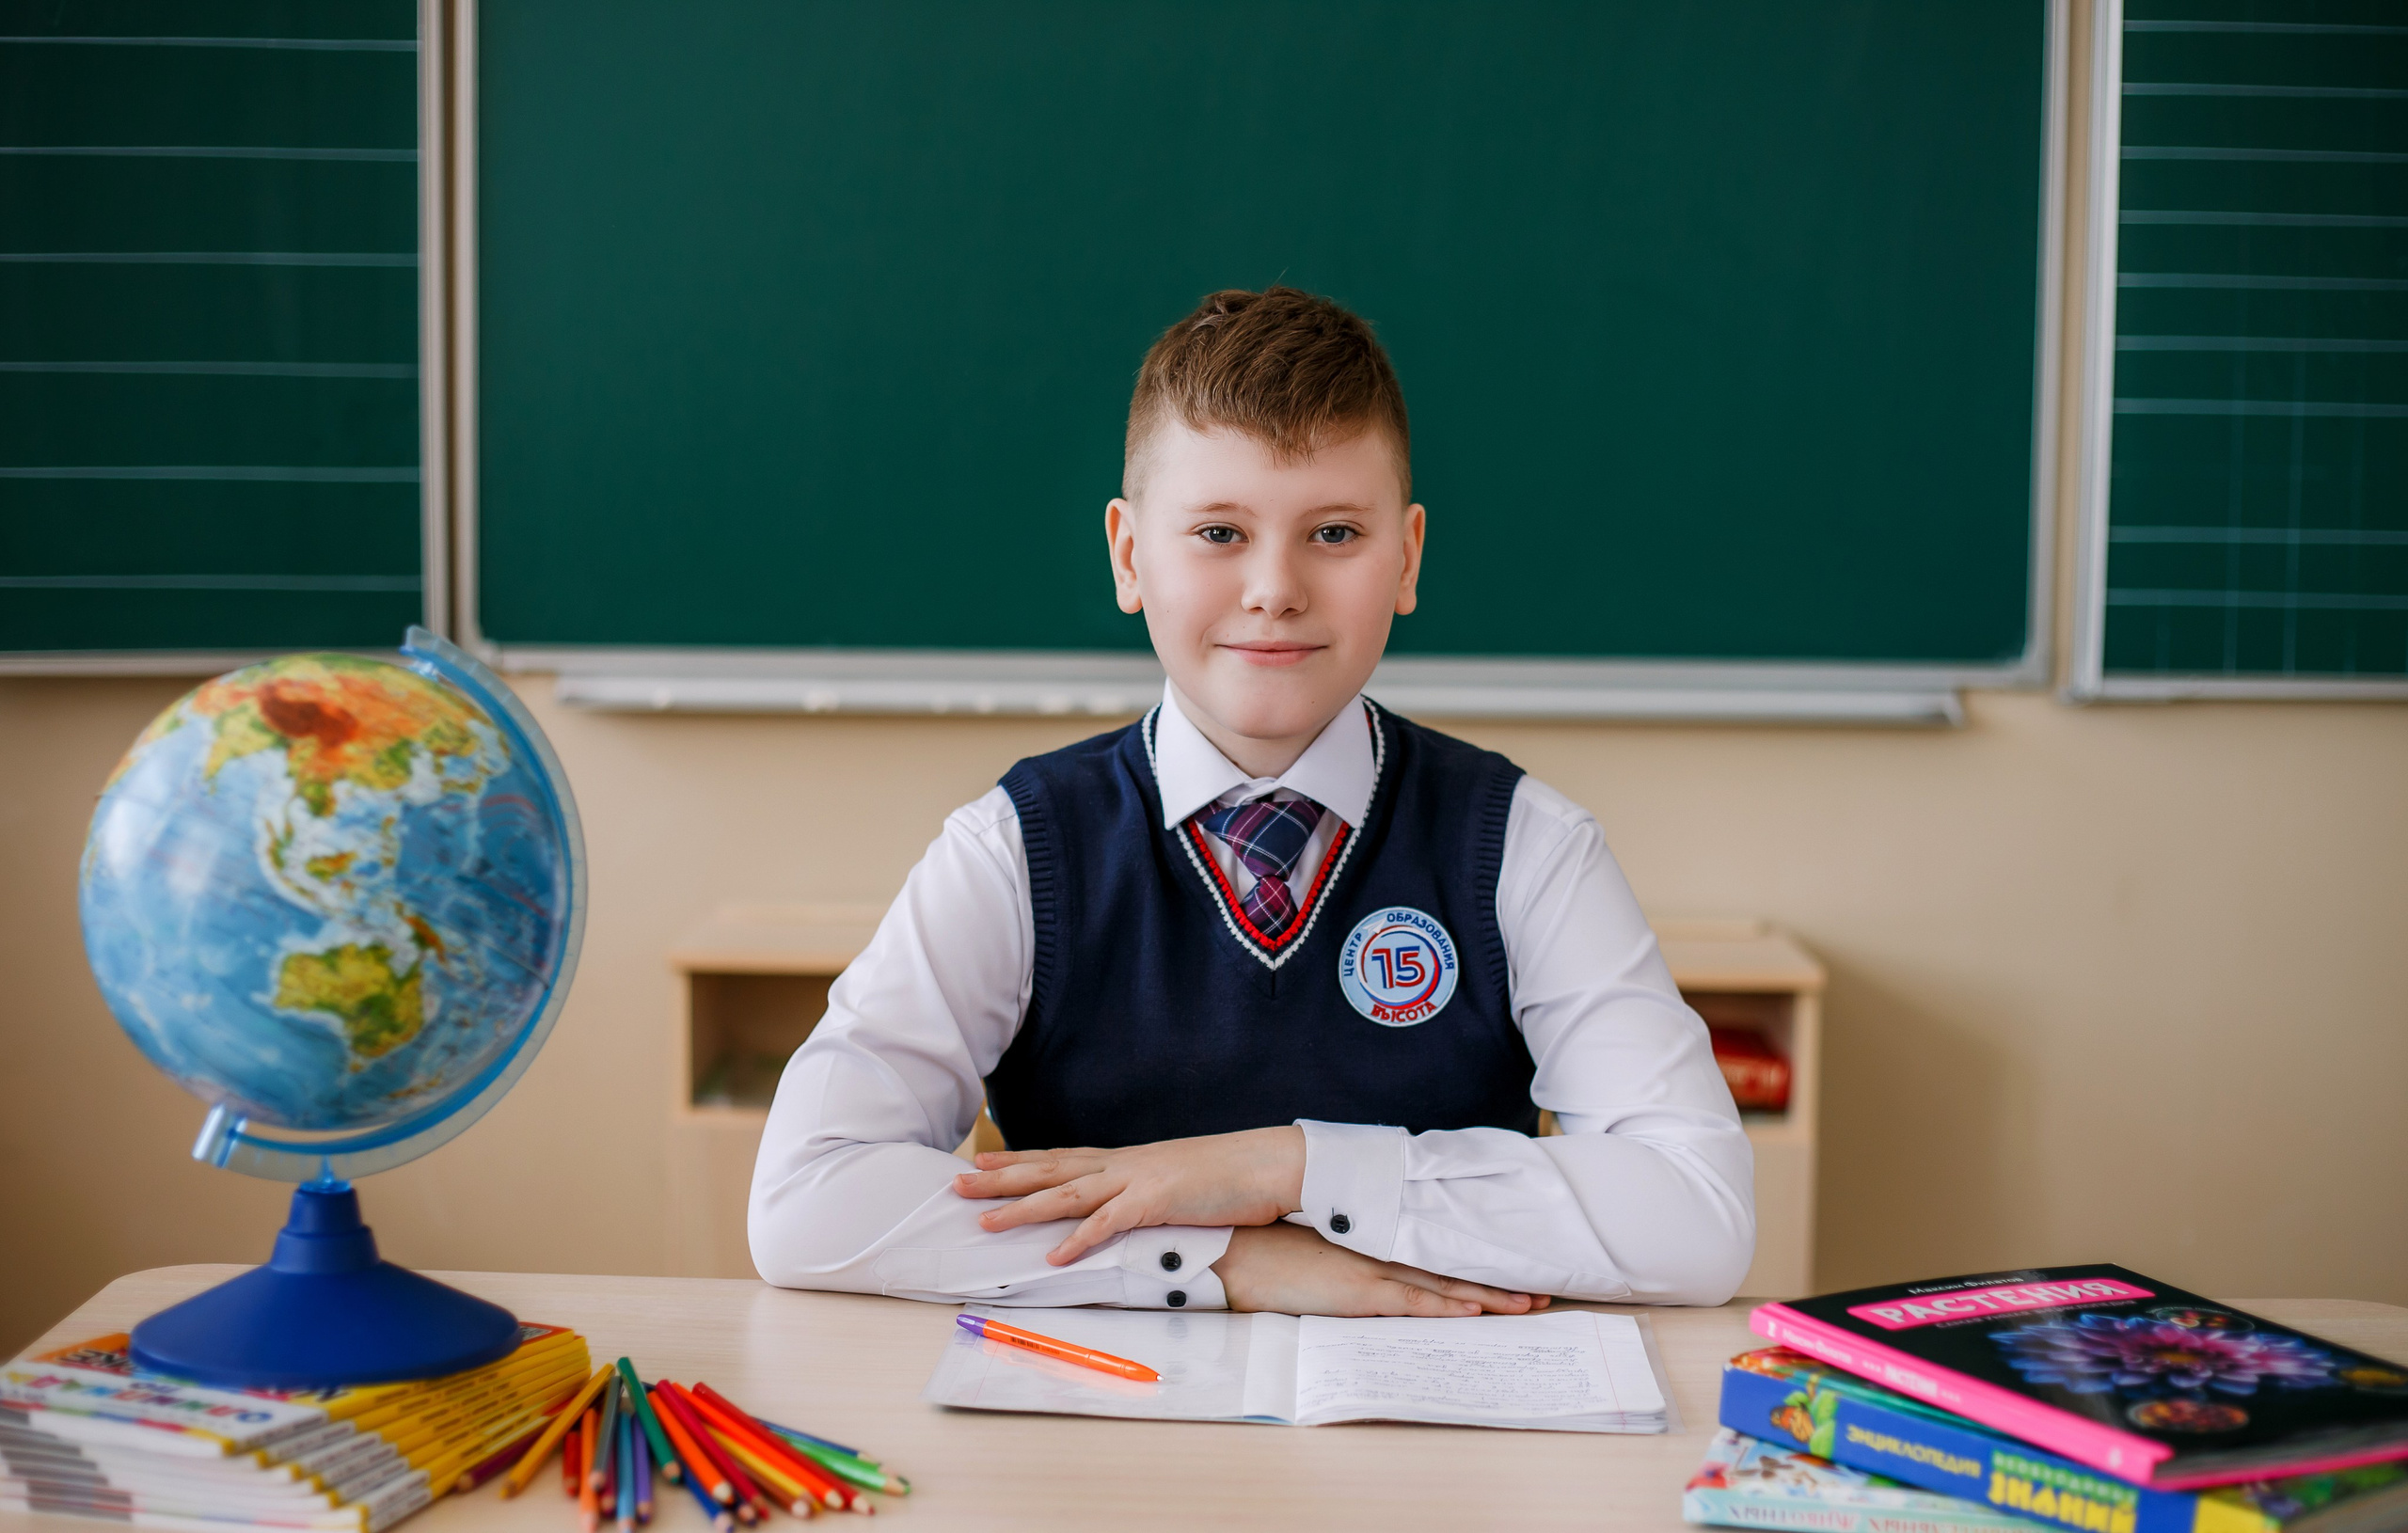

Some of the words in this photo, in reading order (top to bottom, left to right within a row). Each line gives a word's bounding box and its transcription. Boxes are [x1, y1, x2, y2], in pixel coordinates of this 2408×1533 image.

[1343, 932, 1362, 976] ЦЕНТР
[1386, 912, 1454, 970] ОБРАЗОВАНИЯ
[1371, 945, 1426, 989] 15
[1370, 1001, 1437, 1022] ВЫСОТА
[1867, 1282, 2130, 1323] РАСТЕНИЯ
[1846, 1424, 1982, 1479] ЭНЦИКЛОПЕДИЯ
[1988, 1471, 2137, 1533] ЗНАНИЙ
